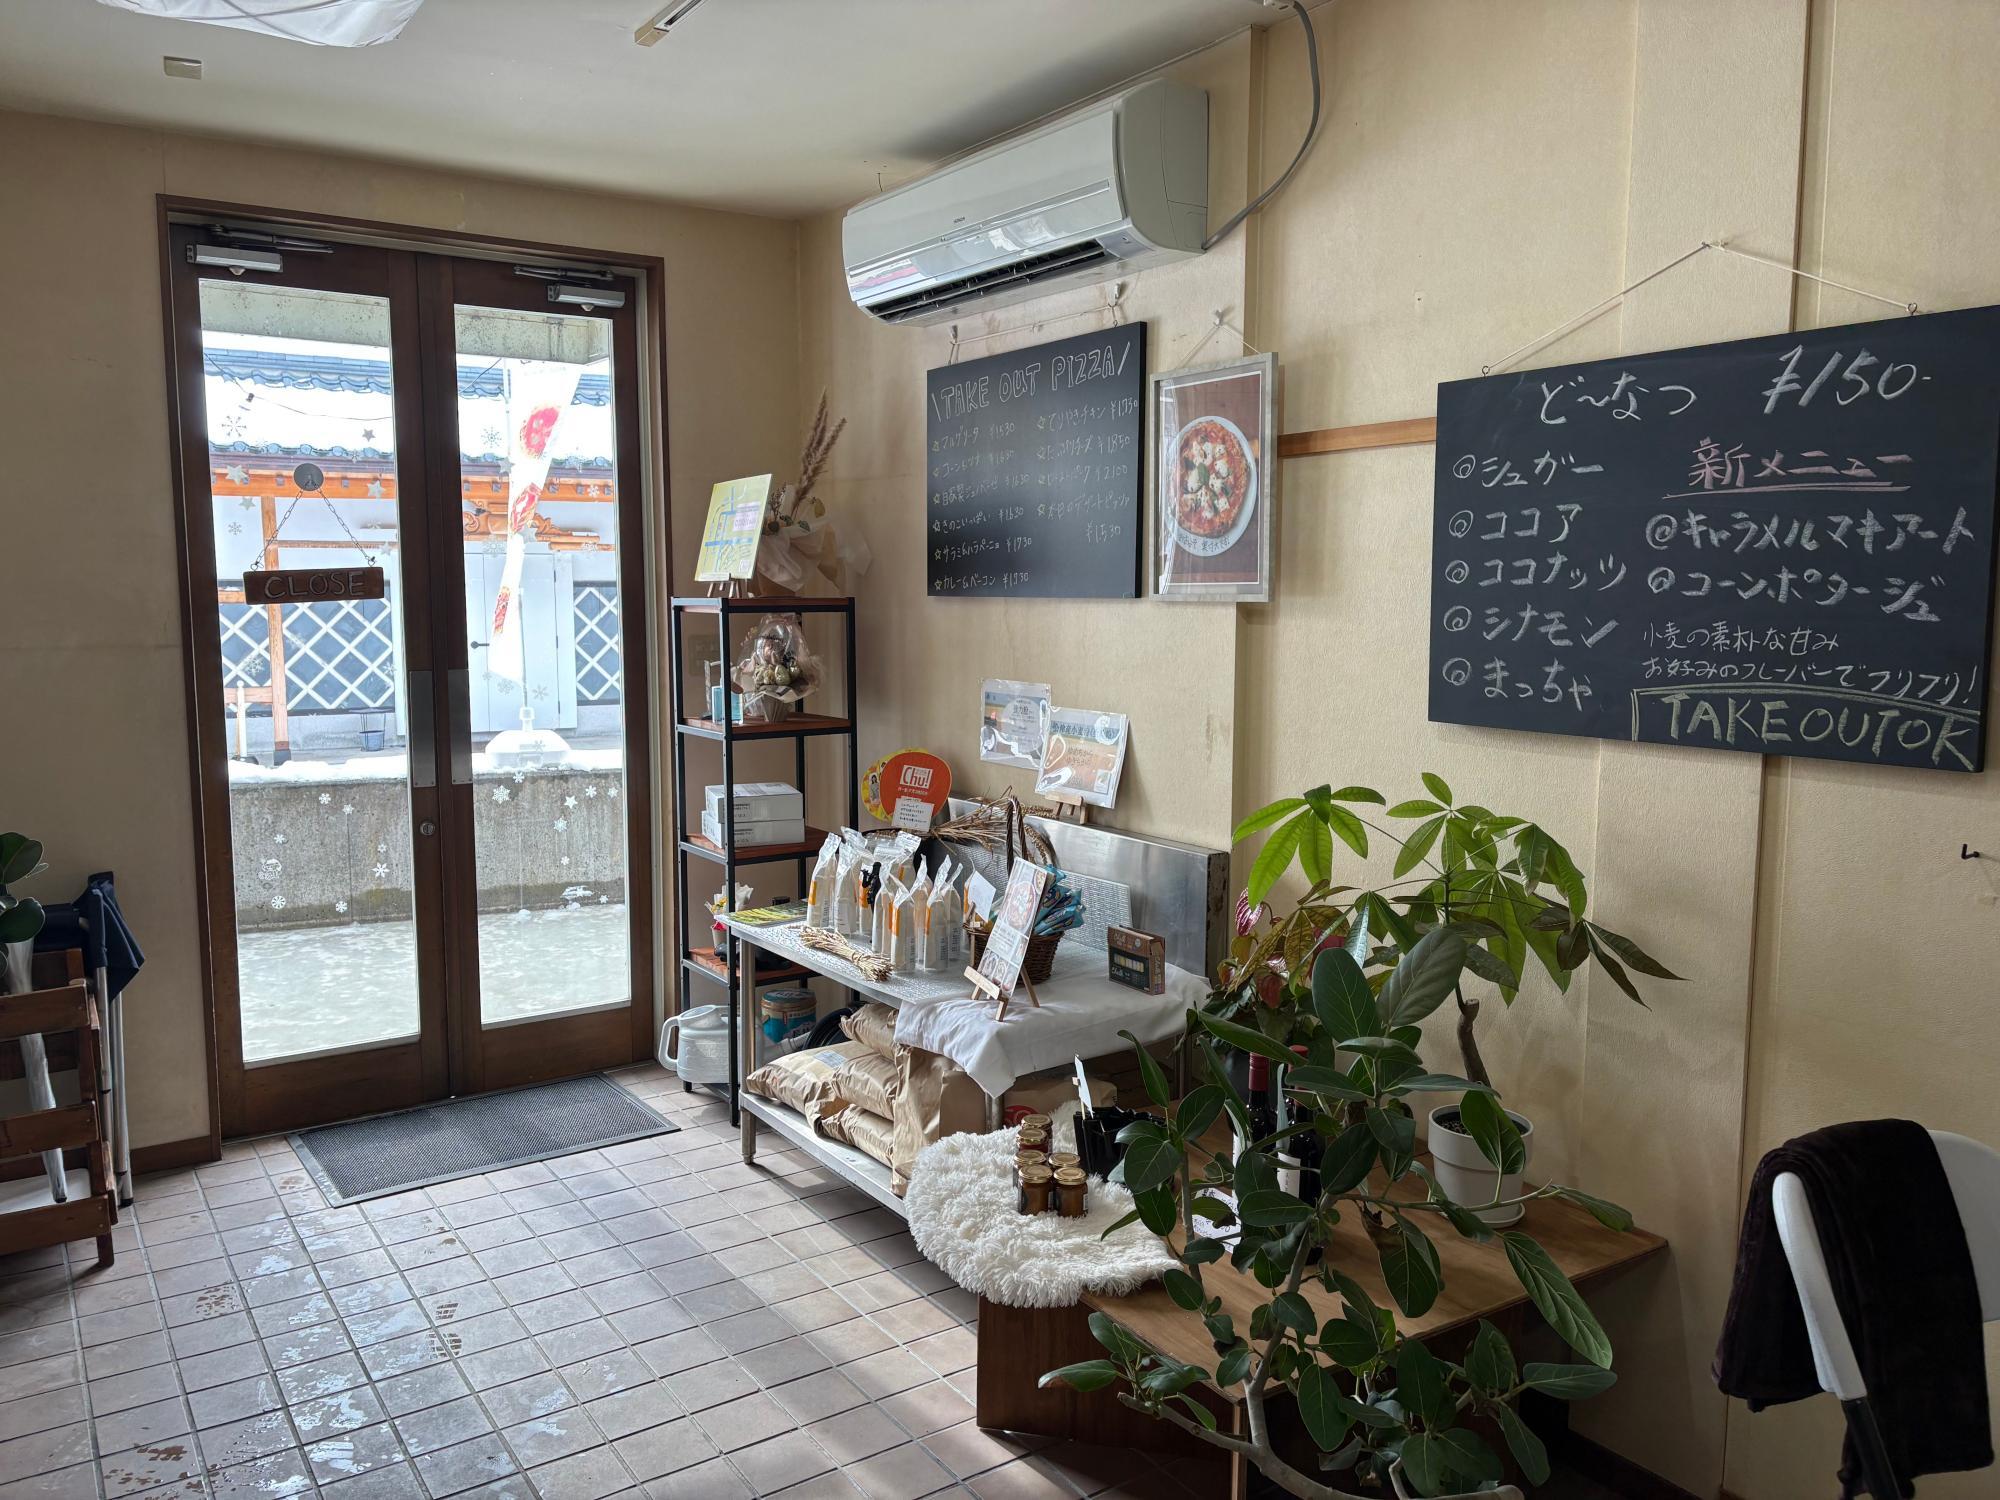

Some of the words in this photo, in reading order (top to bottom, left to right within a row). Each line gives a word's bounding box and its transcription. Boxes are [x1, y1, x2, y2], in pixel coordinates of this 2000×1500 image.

[941, 376, 990, 419] TAKE
[999, 363, 1041, 403] OUT
[1052, 345, 1115, 391] PIZZA
[1482, 450, 1604, 488] シュガー
[1689, 437, 1913, 489] 新メニュー
[1481, 503, 1583, 543] ココア
[1682, 506, 1975, 554] キャラメルマキアート
[264, 570, 364, 599] CLOSE
[1478, 551, 1627, 591] ココナッツ
[1680, 565, 1946, 622] コーンポタージュ
[1483, 602, 1619, 648] シナモン
[1643, 619, 1839, 656] 小麦の素朴な甘み
[1484, 656, 1593, 712] まっちゃ
[902, 766, 931, 788] Chu!
